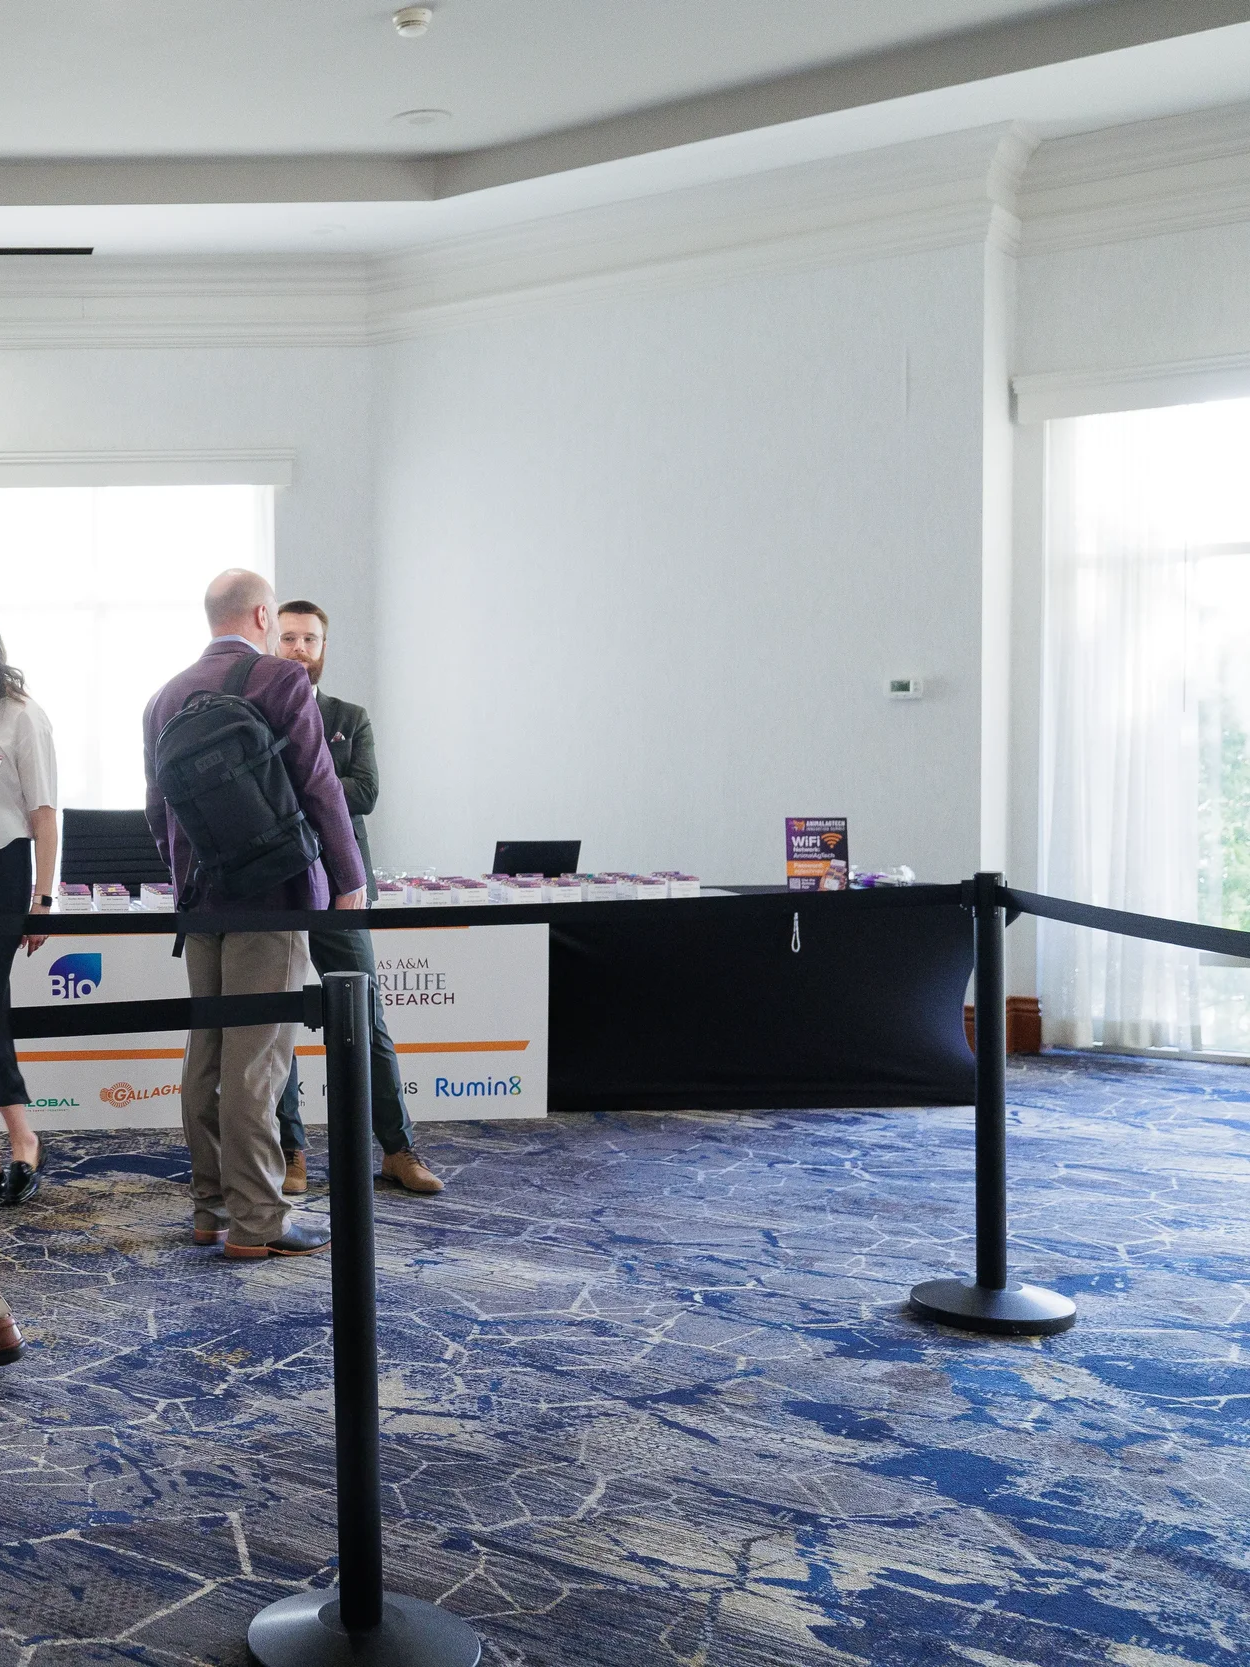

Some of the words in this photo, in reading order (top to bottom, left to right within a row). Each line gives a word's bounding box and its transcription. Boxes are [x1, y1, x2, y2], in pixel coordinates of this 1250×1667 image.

[791, 835, 821, 847] WiFi
[396, 957, 430, 969] A&M
[49, 973, 97, 999] Bio
[377, 970, 447, 992] RILIFE
[381, 993, 455, 1007] SEARCH
[113, 1084, 182, 1102] GALLAGH
[435, 1075, 522, 1097] Rumin8
[26, 1098, 80, 1108] LOBAL
